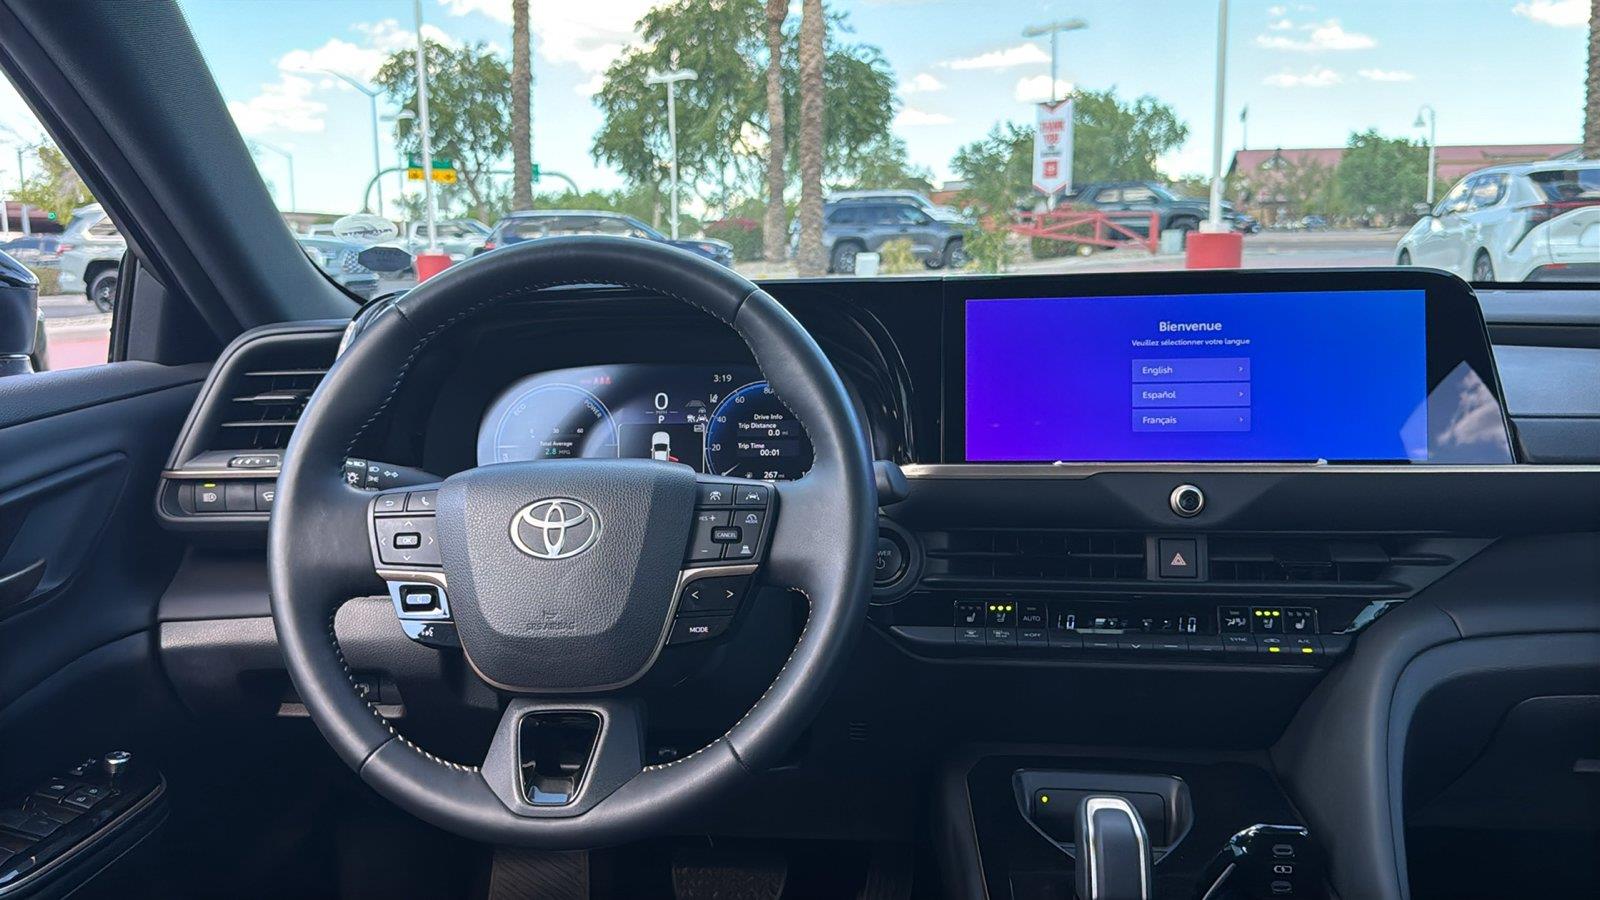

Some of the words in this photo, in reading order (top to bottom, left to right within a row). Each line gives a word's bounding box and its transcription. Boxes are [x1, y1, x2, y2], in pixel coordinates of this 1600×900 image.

[1159, 320, 1222, 332] Bienvenue
[1224, 338, 1250, 346] langue
[1142, 366, 1173, 376] English
[713, 374, 732, 383] 3:19
[1142, 390, 1176, 400] Español
[654, 392, 669, 410] 0
[658, 415, 665, 424] P
[1142, 416, 1177, 426] Français
[738, 422, 750, 430] Trip
[767, 429, 781, 437] 0.0
[552, 440, 573, 448] Average
[711, 443, 721, 452] 20
[738, 442, 750, 450] Trip
[759, 448, 780, 457] 00:01
[763, 471, 779, 479] 267
[716, 531, 737, 539] CANCEL
[689, 626, 709, 634] MODE
